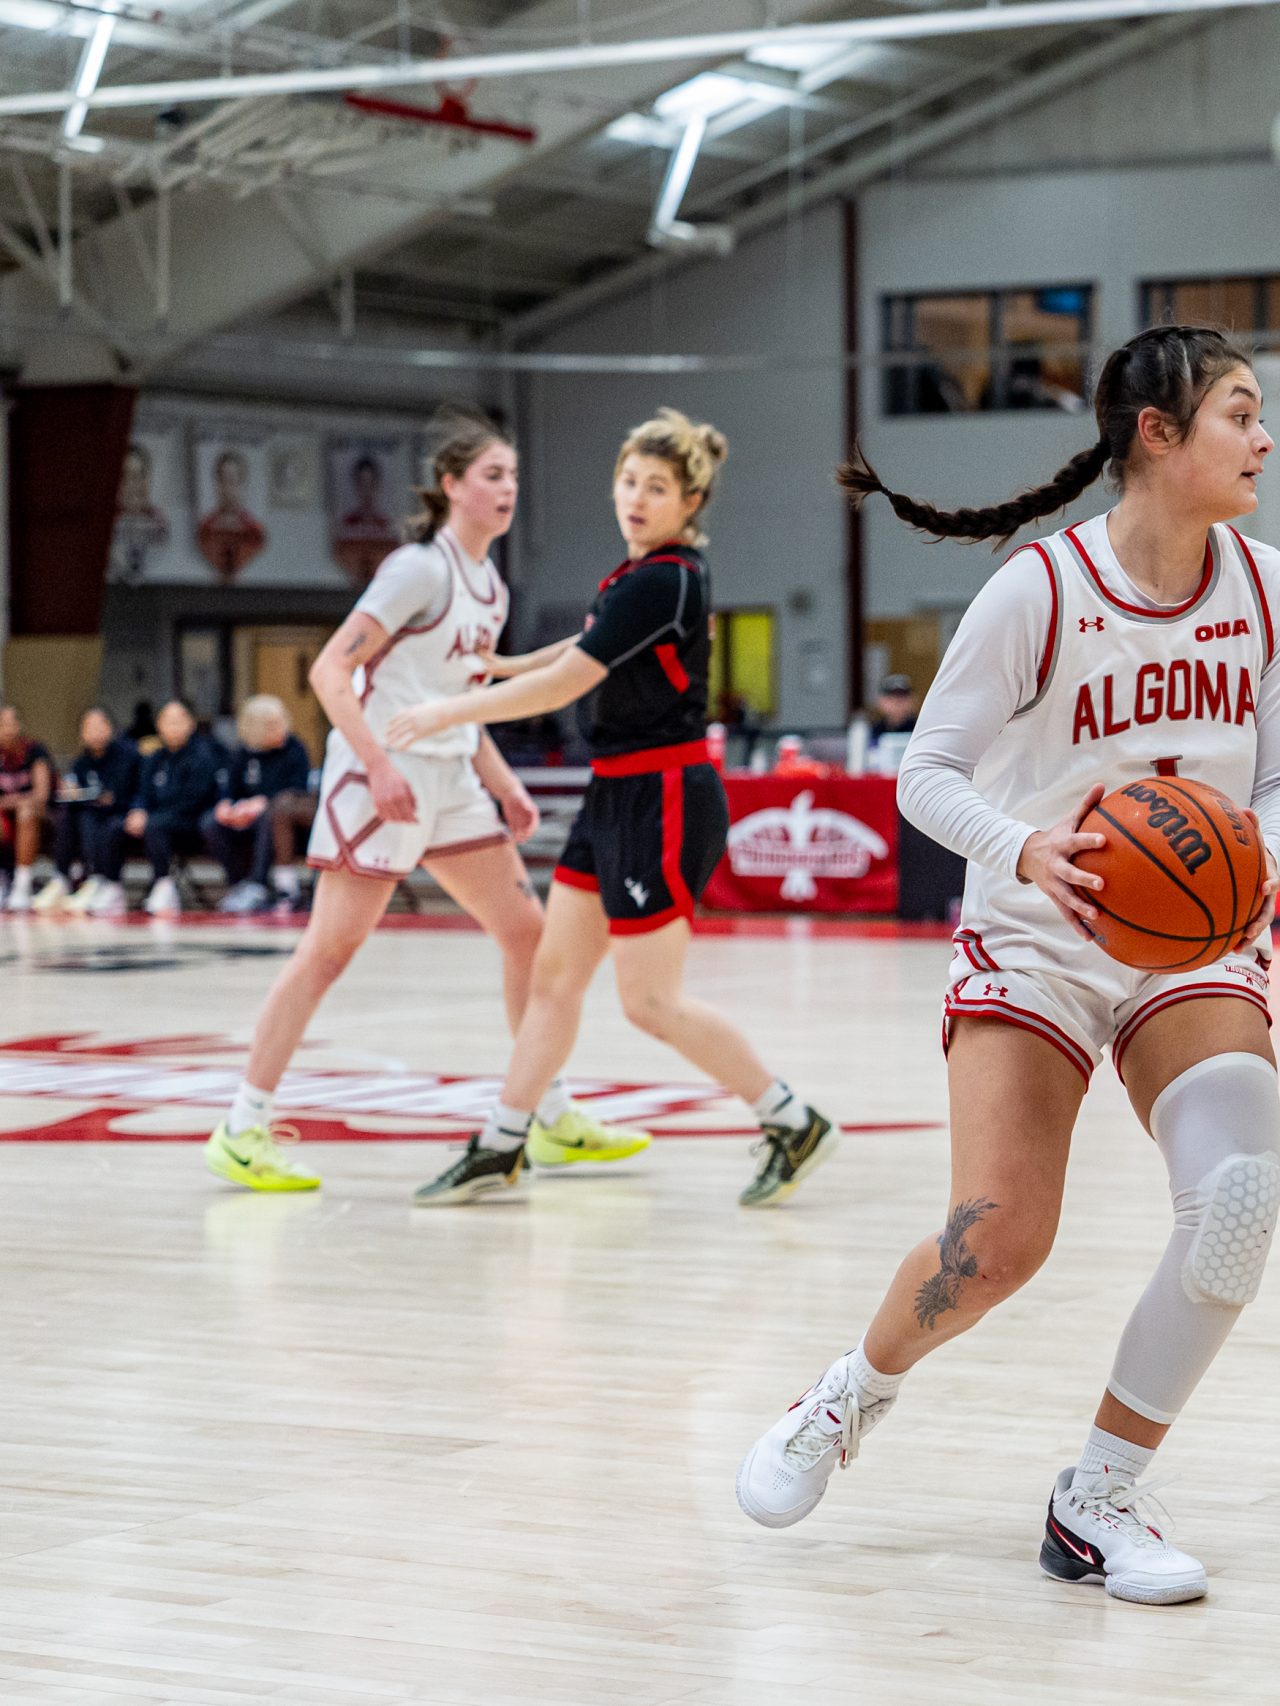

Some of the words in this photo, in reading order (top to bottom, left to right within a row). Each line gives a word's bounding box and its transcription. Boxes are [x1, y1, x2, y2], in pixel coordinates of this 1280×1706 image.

[1194, 618, 1251, 643] OUA
[1072, 659, 1257, 745] ALGOMA
[1121, 783, 1212, 876] Wilson
